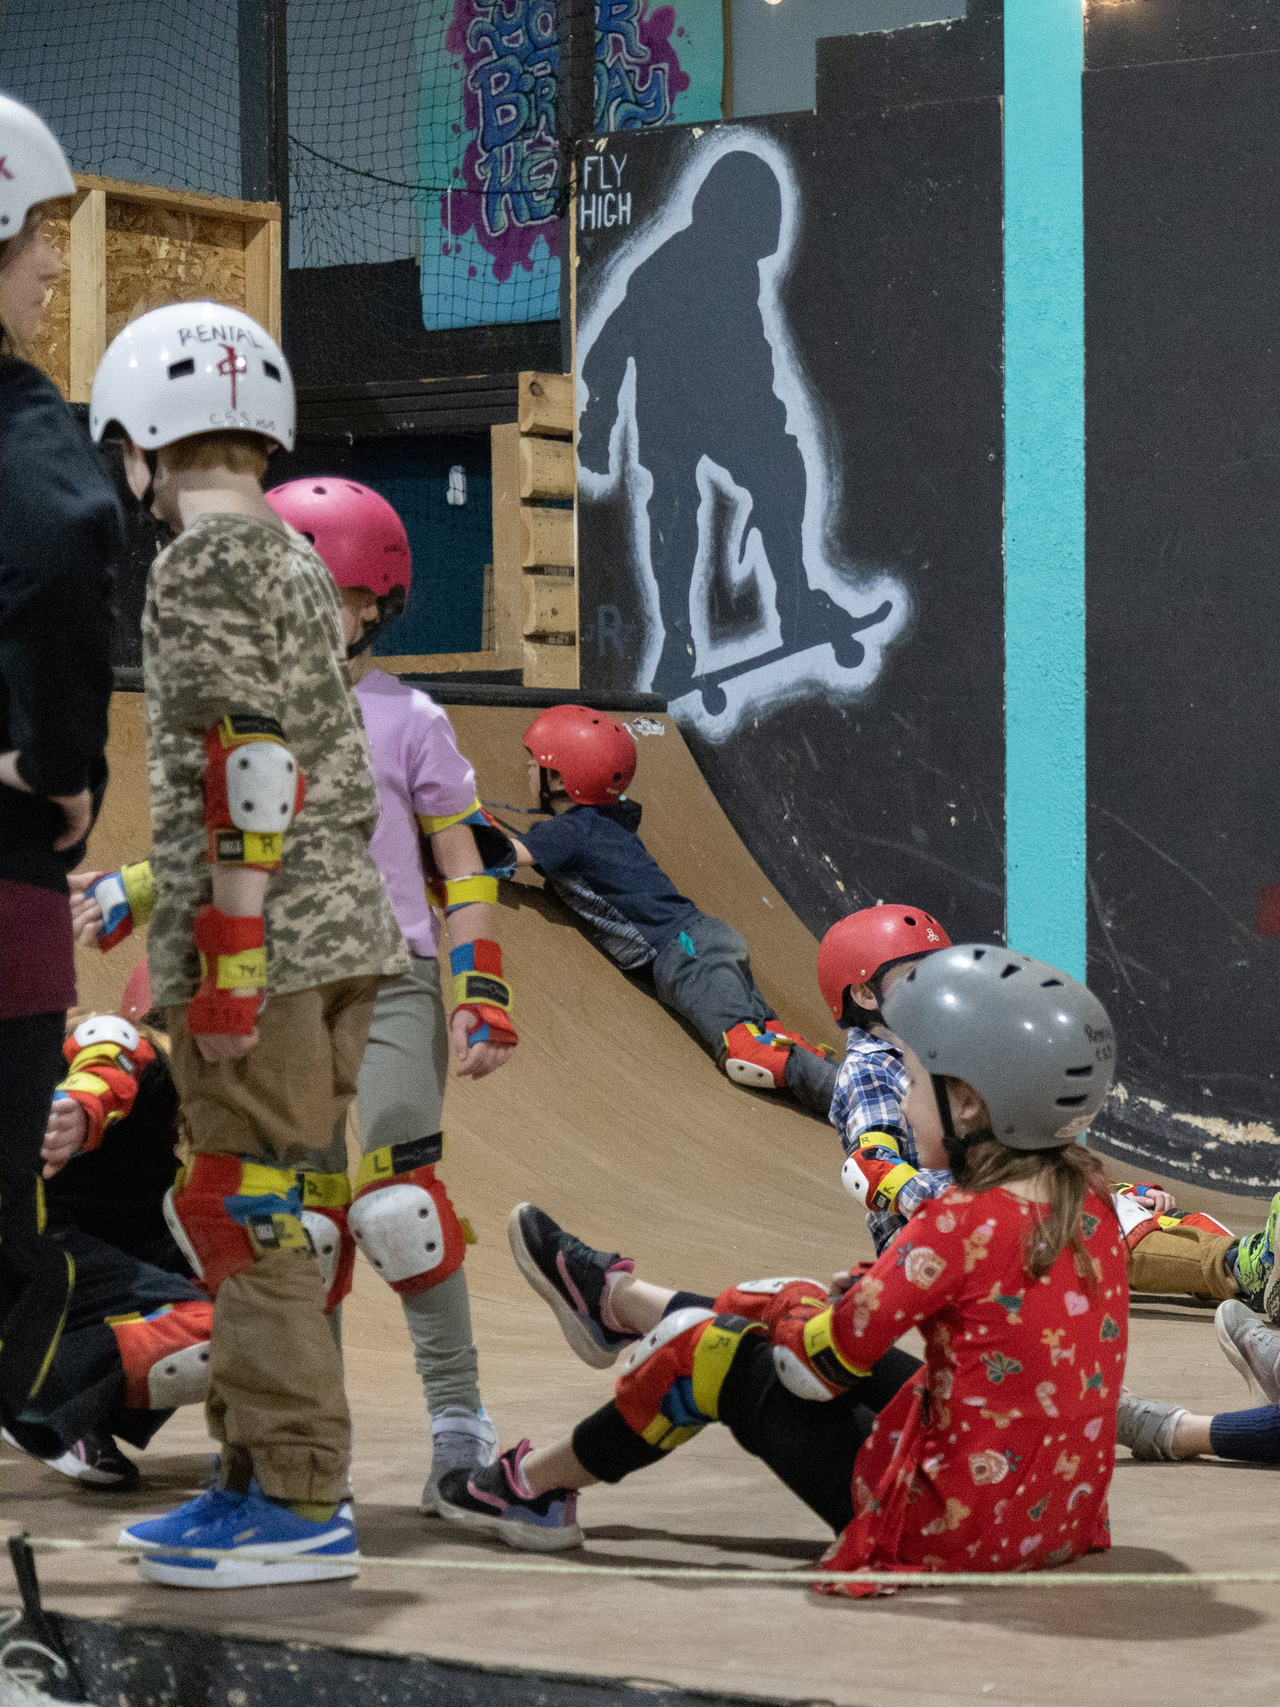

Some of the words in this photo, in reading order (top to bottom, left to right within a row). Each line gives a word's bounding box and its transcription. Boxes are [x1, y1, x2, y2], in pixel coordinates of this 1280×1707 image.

[583, 153, 628, 191] FLY
[580, 192, 632, 231] HIGH
[177, 324, 263, 349] RENTAL
[372, 1153, 390, 1175] L
